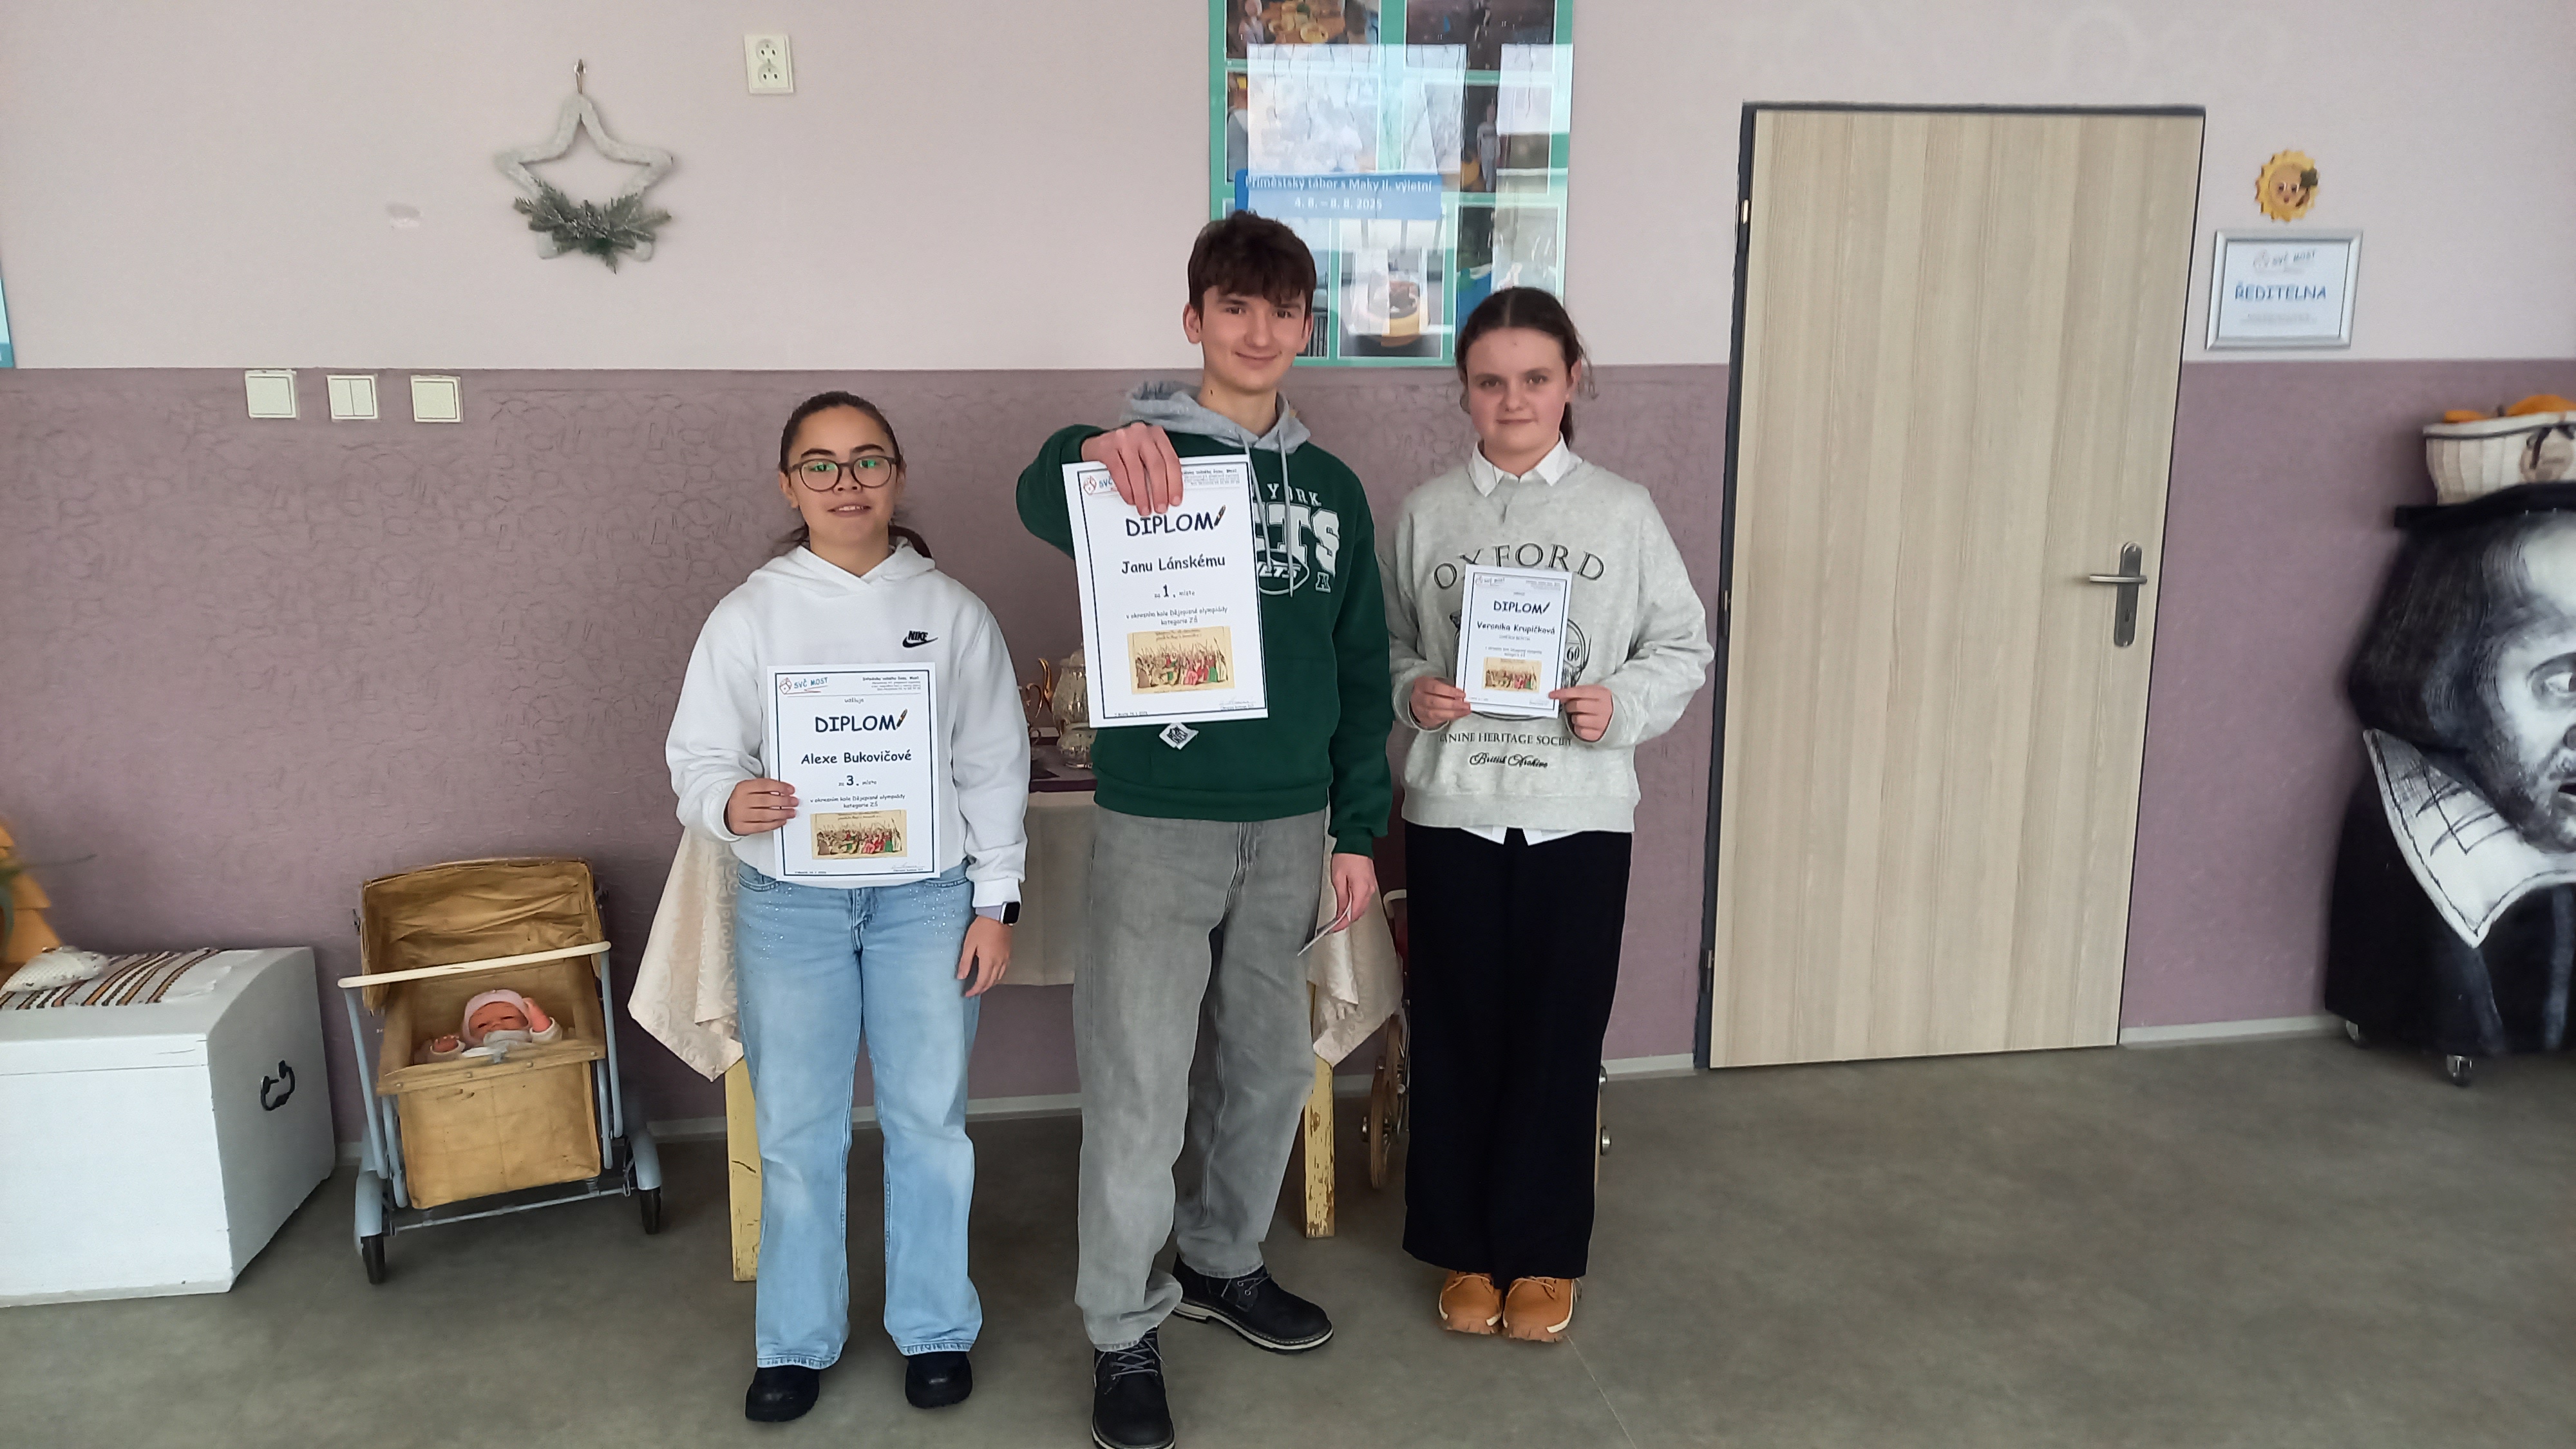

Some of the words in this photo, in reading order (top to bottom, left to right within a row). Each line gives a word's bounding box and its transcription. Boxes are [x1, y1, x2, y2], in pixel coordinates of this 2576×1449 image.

[2235, 280, 2326, 301] ŘEDITELNA
[1126, 511, 1213, 536] DIPLOM
[1121, 561, 1153, 574] Janu
[1159, 553, 1225, 571] Lánskému
[1493, 600, 1542, 615] DIPLOM
[1477, 621, 1510, 632] Veronika
[1513, 624, 1555, 634] Krupičková
[908, 630, 928, 641] NIKE
[1567, 646, 1580, 661] 60
[794, 678, 807, 688] SVČ
[810, 677, 828, 687] MOST
[815, 715, 896, 732] DIPLOM
[1479, 732, 1533, 744] HERITAGE
[801, 753, 837, 764] Alexe
[844, 749, 912, 763] Bukovičové
